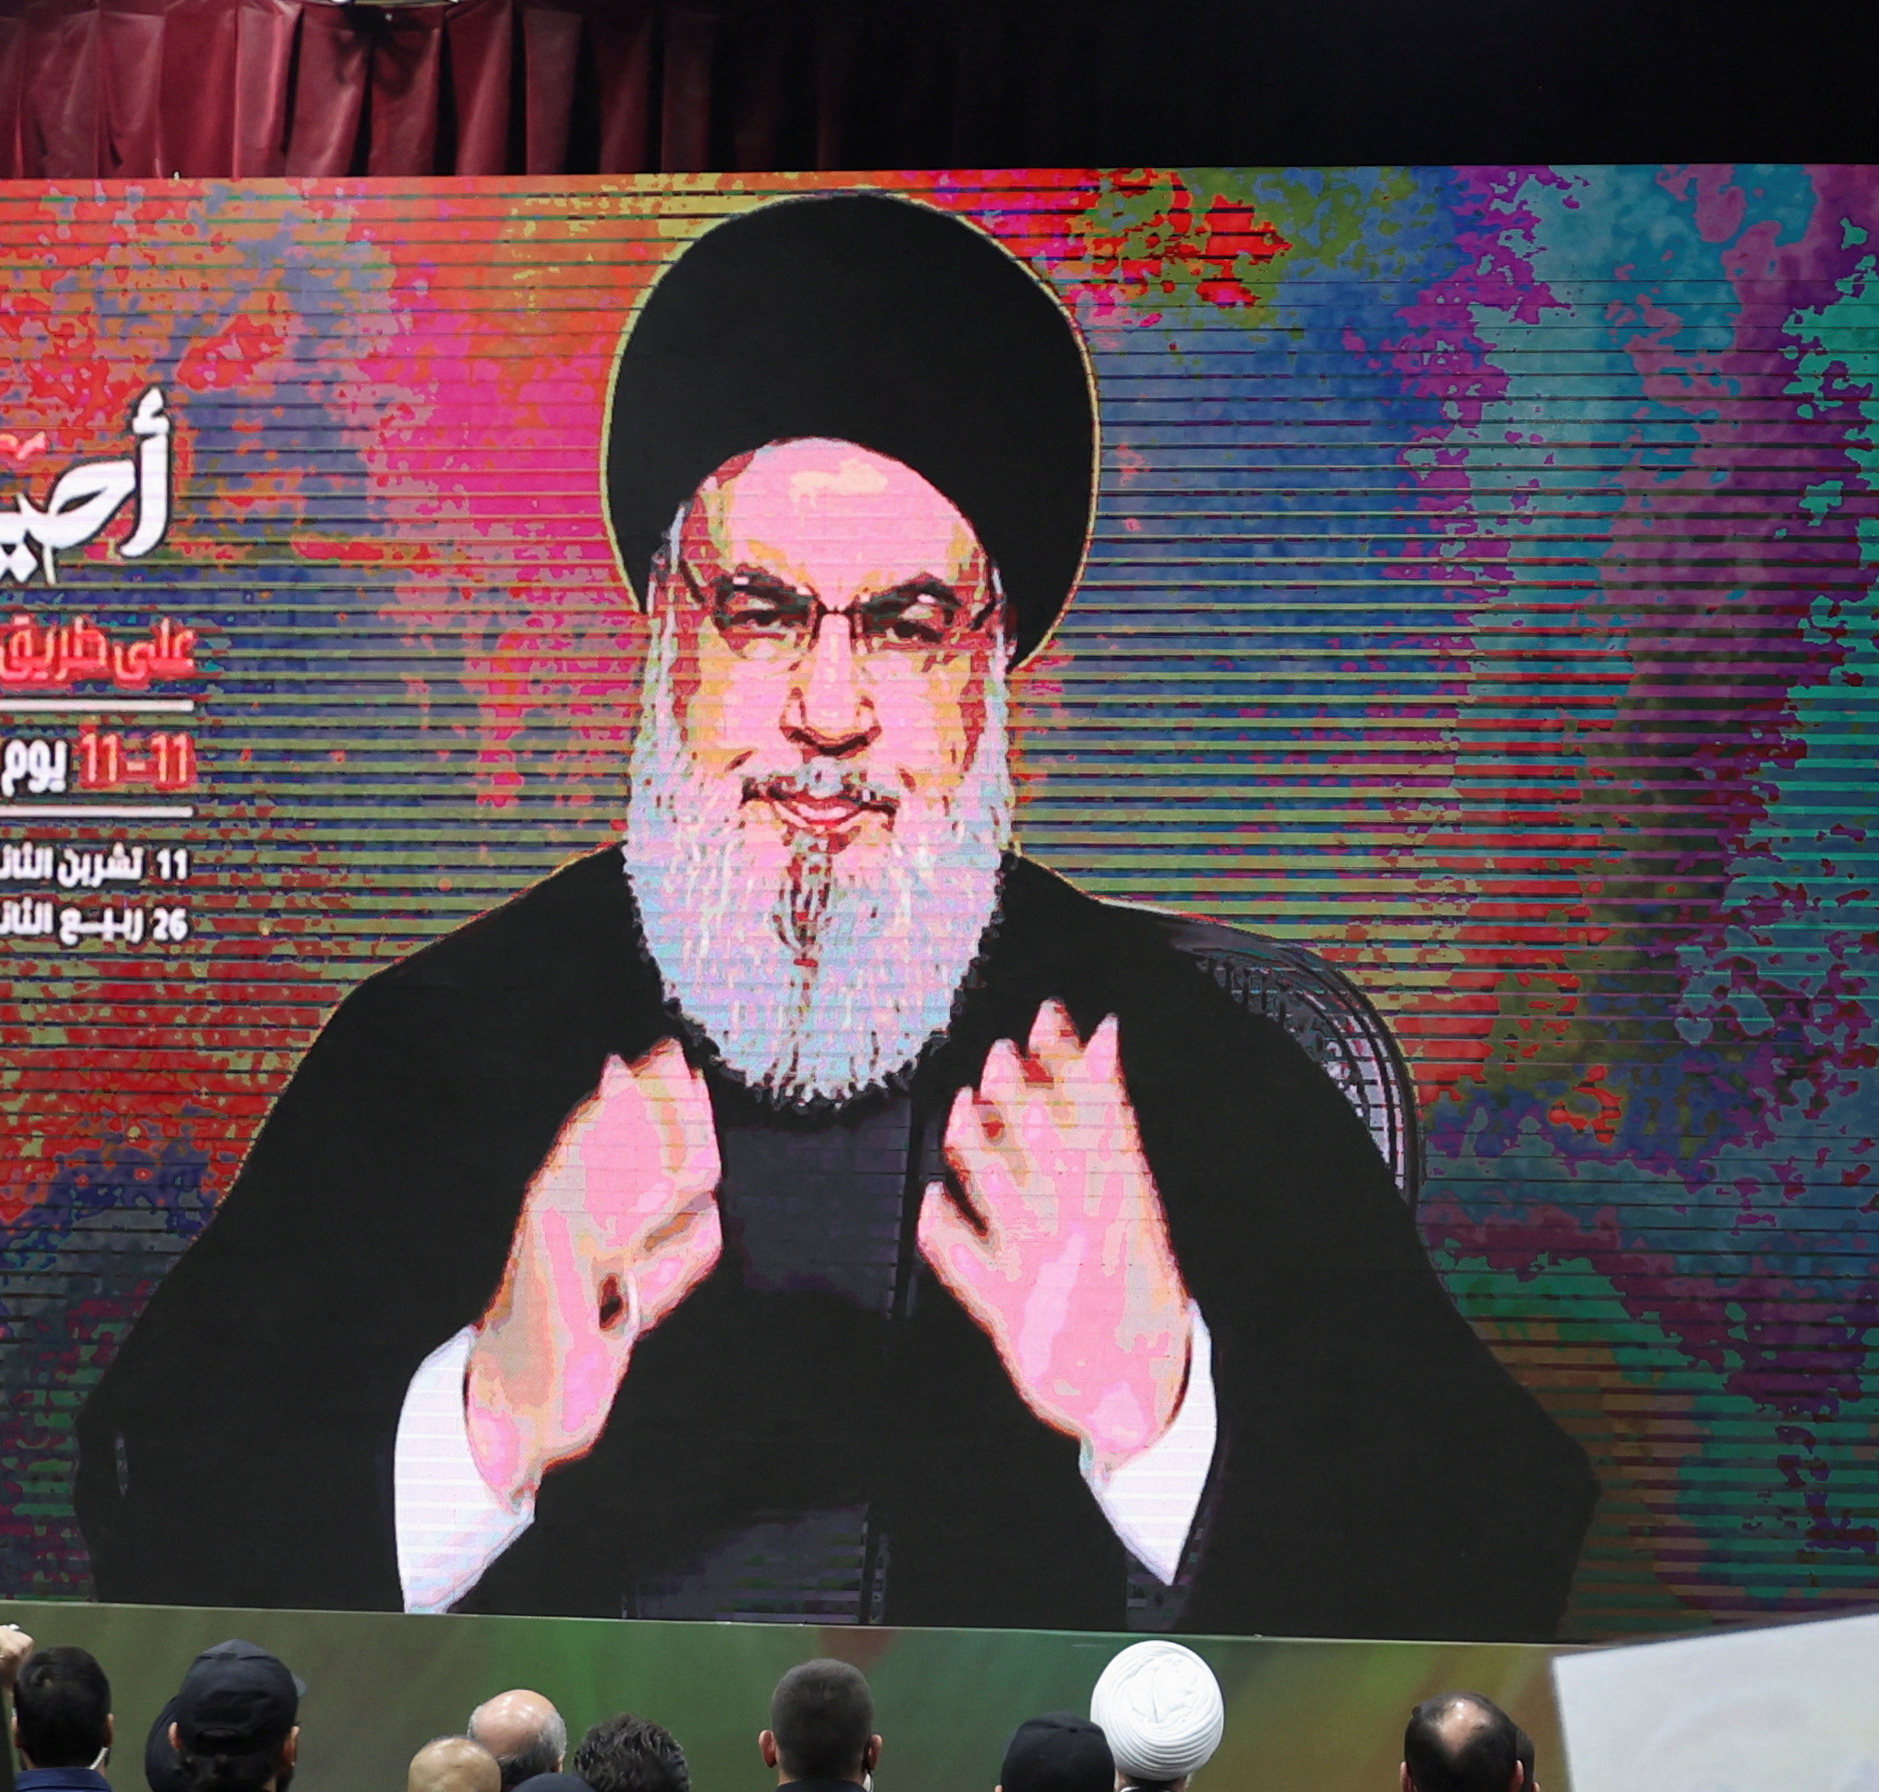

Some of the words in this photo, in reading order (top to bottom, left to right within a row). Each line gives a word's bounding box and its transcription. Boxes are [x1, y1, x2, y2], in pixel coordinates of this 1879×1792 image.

[114, 616, 197, 682] على
[1, 740, 69, 798] يوم
[82, 733, 191, 784] 11-11
[58, 842, 145, 887] تشرين
[157, 848, 190, 880] 11
[60, 907, 145, 945] ربيع
[154, 908, 190, 941] 26
